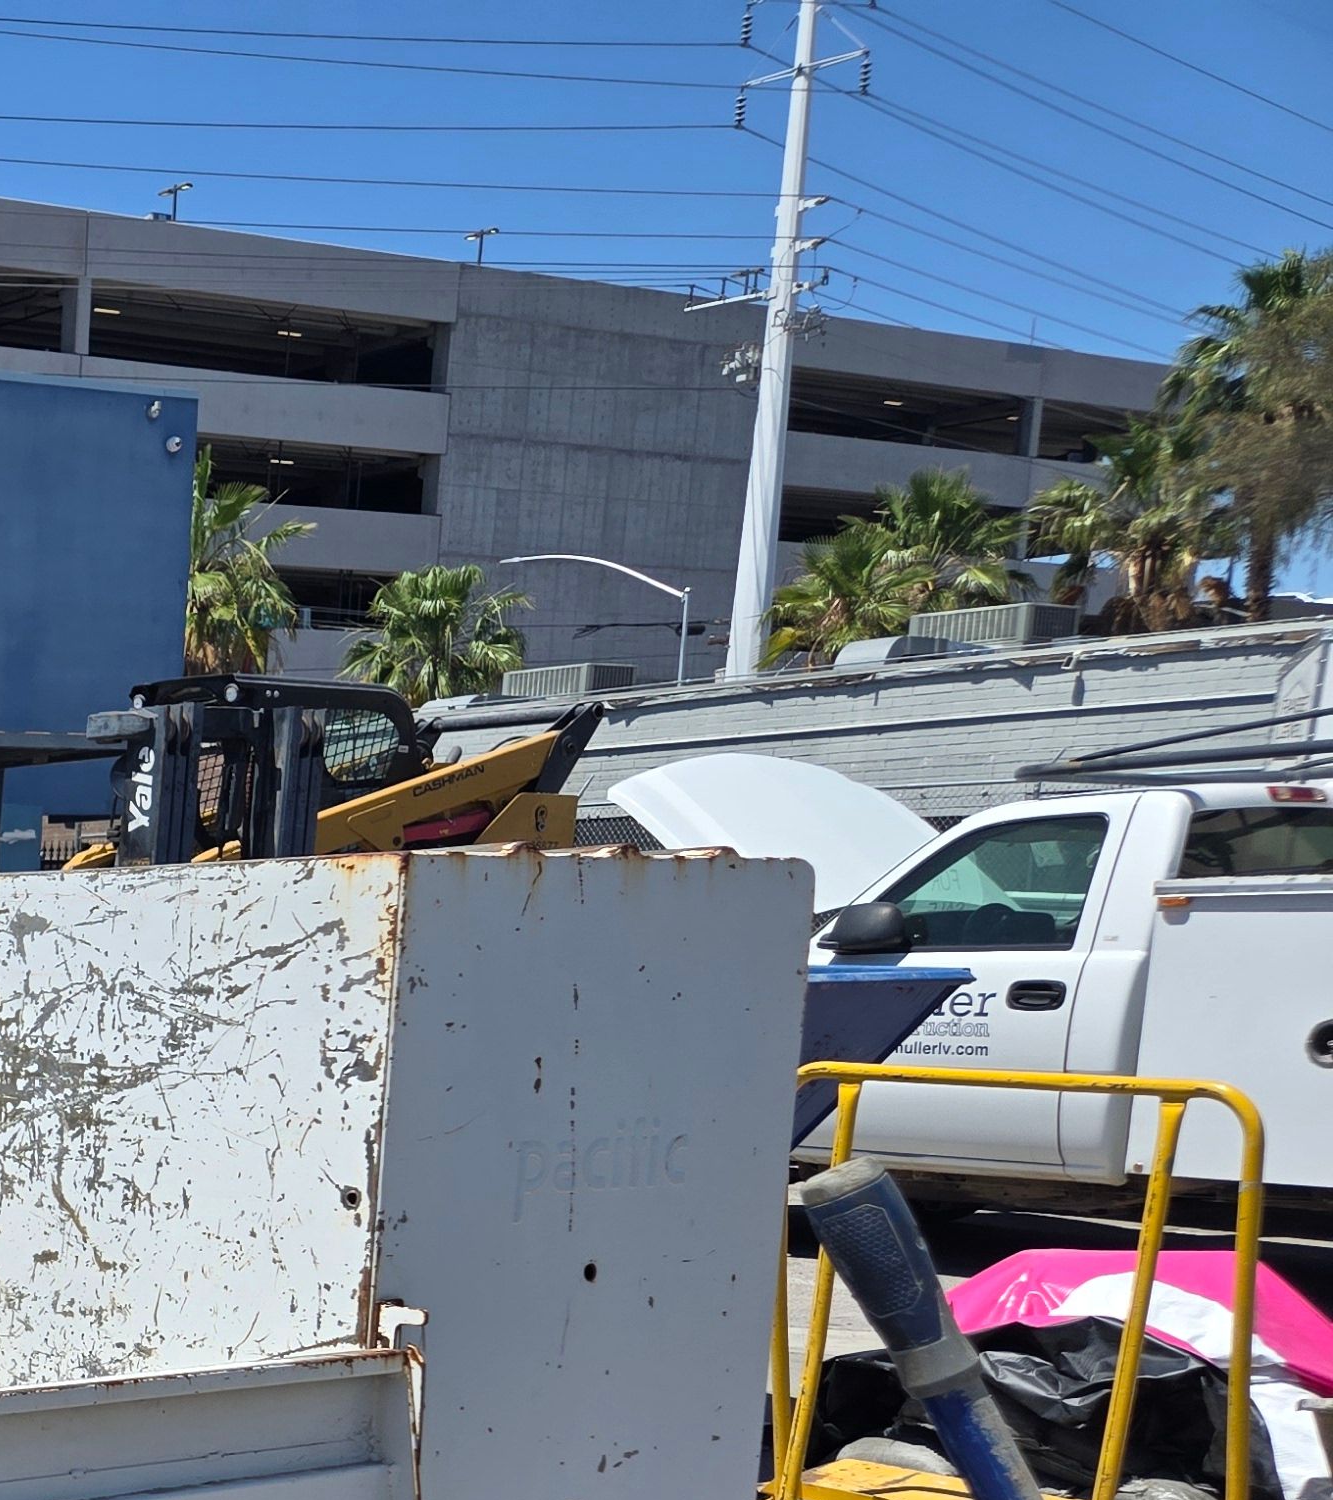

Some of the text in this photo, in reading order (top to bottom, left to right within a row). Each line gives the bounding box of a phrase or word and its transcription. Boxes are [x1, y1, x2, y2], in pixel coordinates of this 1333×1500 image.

[127, 746, 156, 832] Yale
[412, 765, 485, 797] CASHMAN
[511, 1116, 688, 1224] pacific
